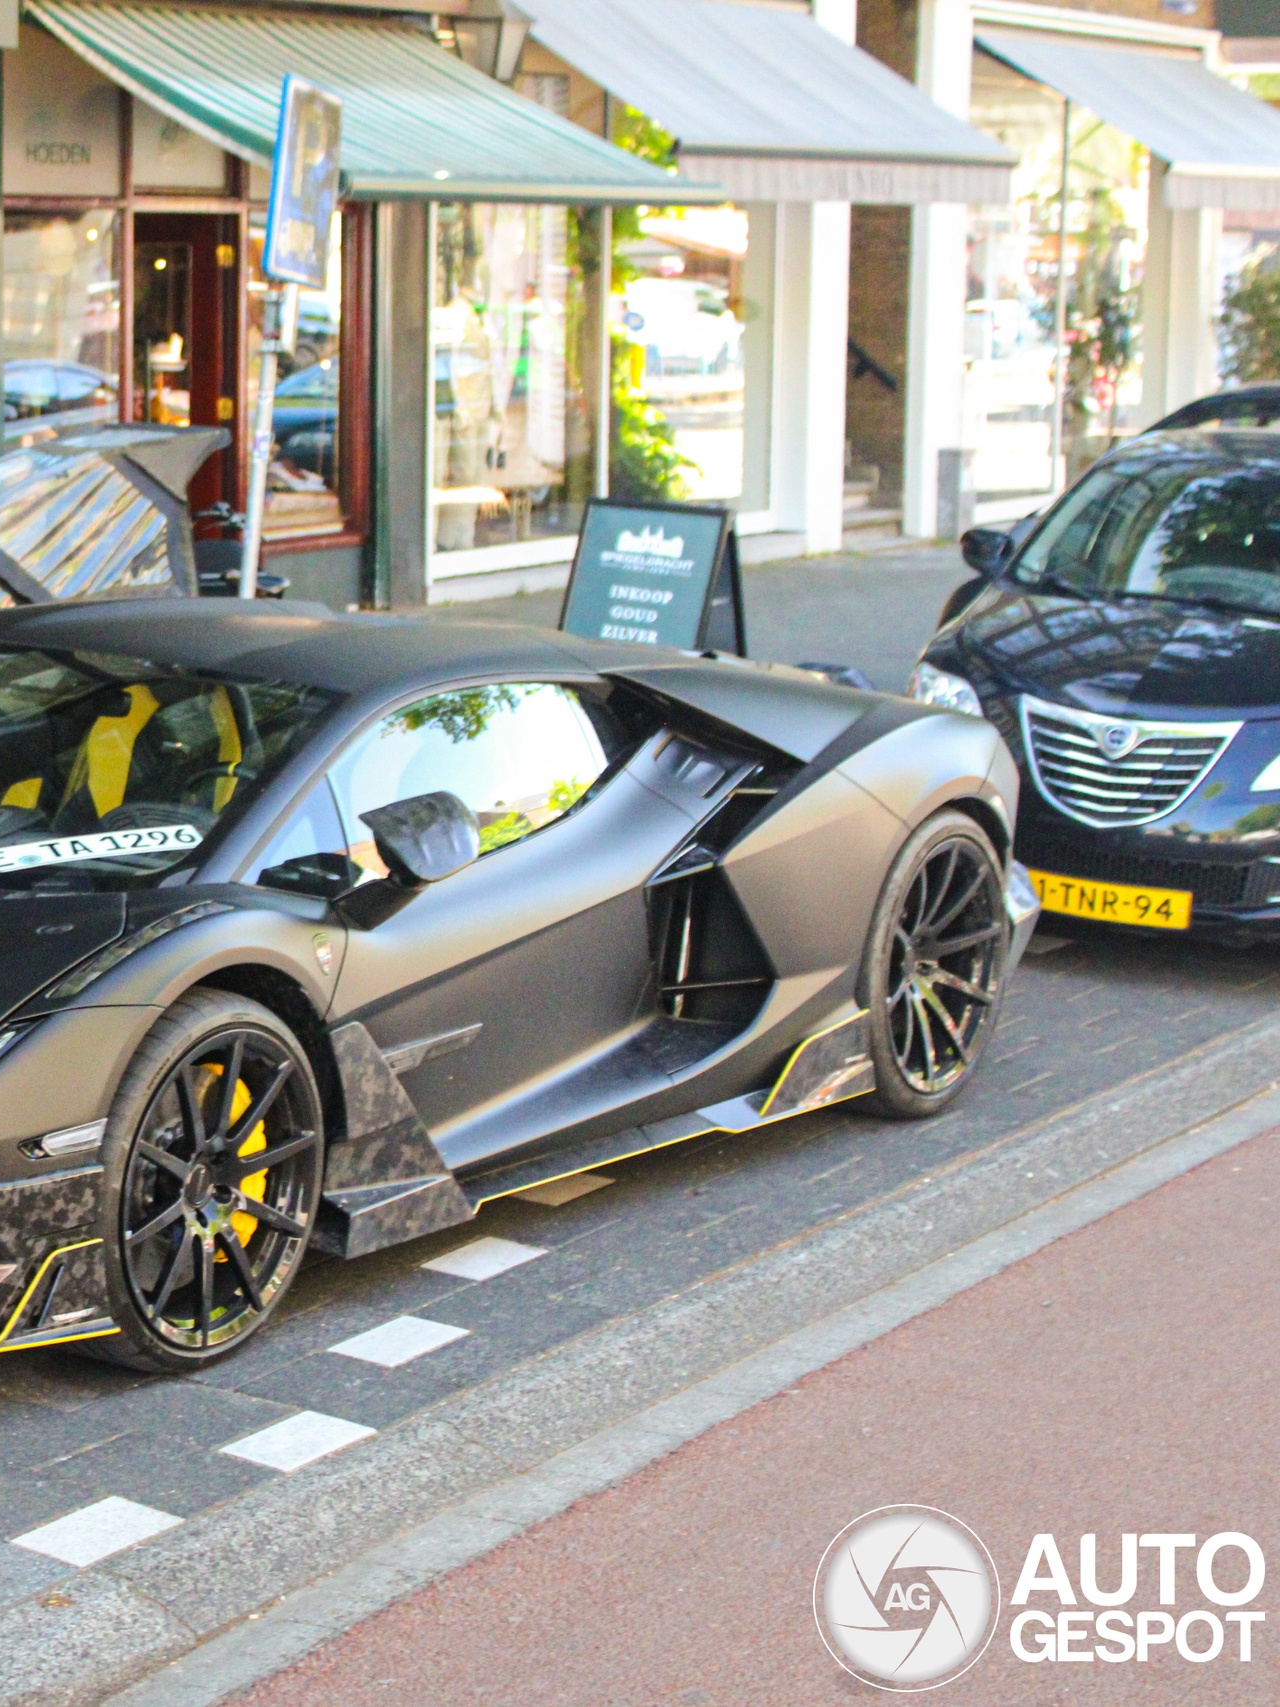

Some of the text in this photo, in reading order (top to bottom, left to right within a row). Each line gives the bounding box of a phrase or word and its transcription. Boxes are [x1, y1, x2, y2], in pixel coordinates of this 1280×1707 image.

[25, 143, 91, 165] HOEDEN
[600, 551, 695, 571] SPIEGELGRACHT
[609, 584, 674, 605] INKOOP
[610, 605, 658, 623] GOUD
[600, 624, 658, 644] ZILVER
[39, 840, 94, 858] TA
[99, 828, 198, 851] 1296
[1038, 878, 1174, 922] 1-TNR-94
